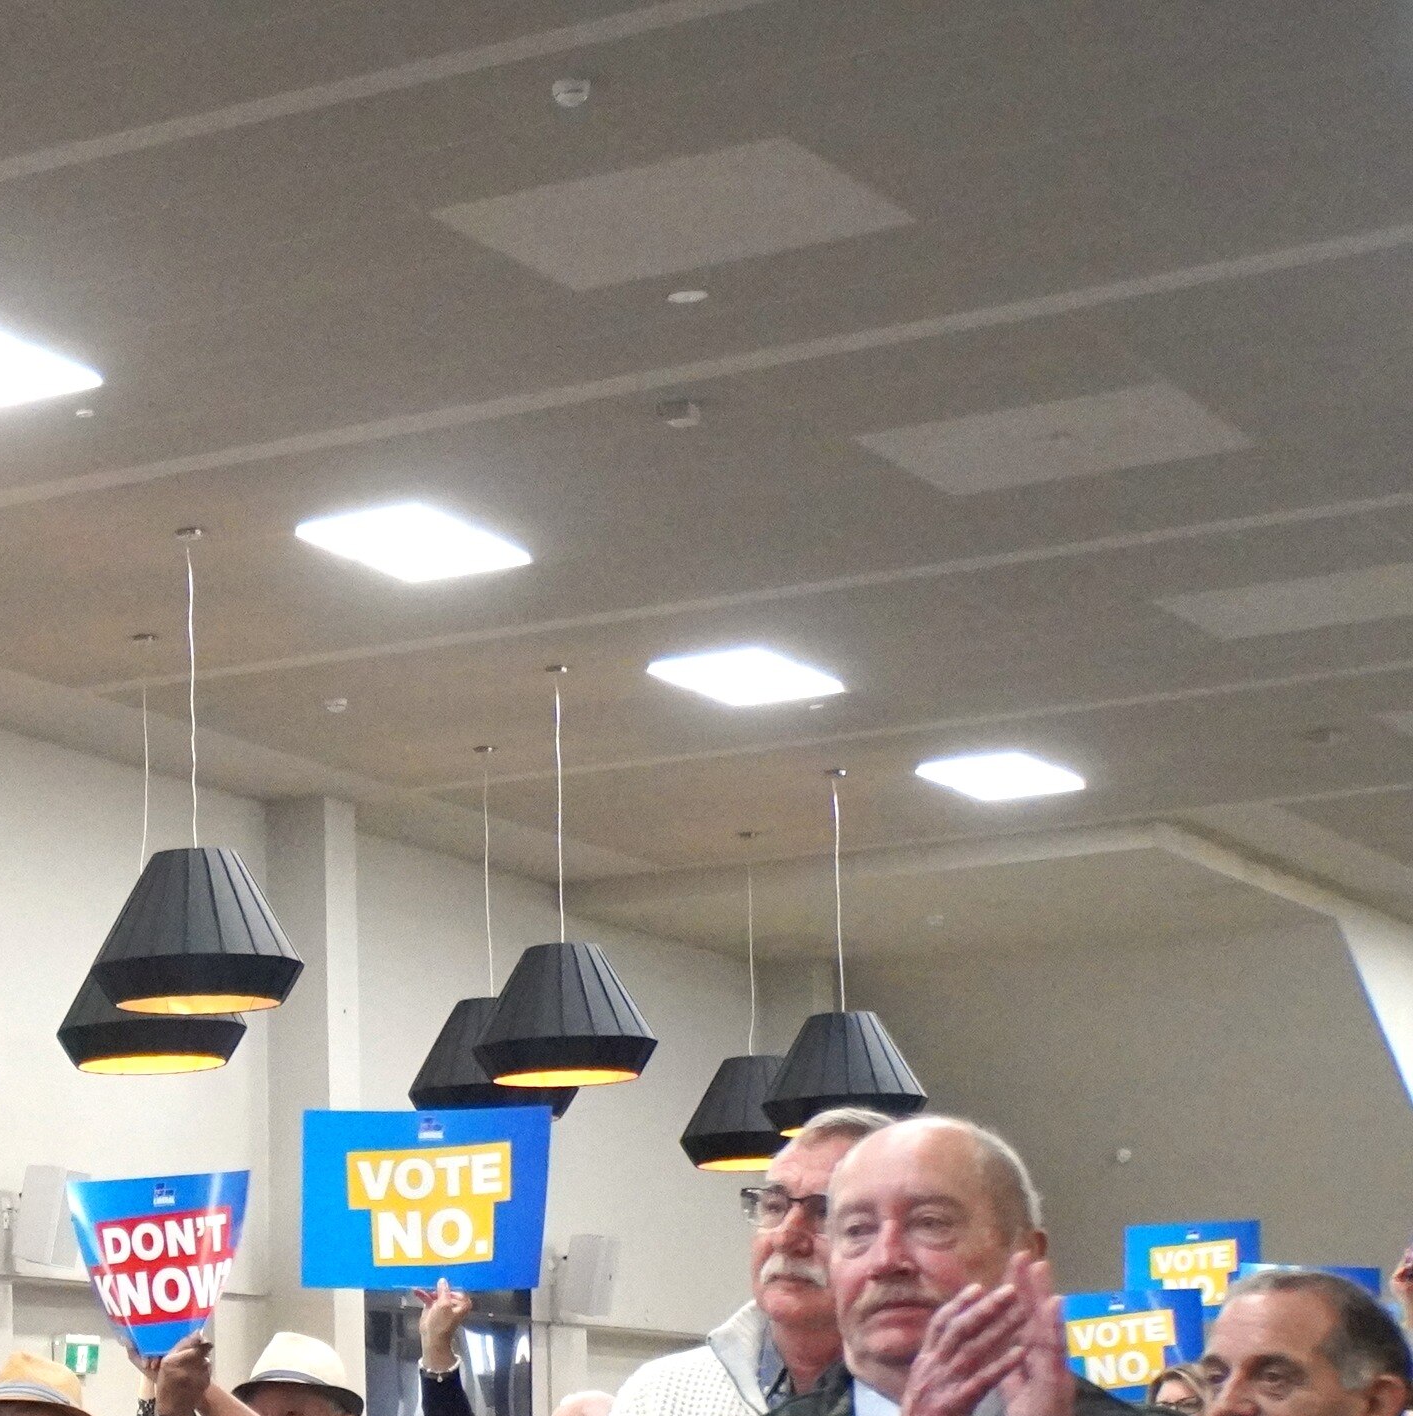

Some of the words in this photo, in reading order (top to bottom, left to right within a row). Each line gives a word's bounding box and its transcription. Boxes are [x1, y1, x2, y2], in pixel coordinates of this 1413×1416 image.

[356, 1152, 503, 1200] VOTE
[101, 1213, 227, 1265] DON'T
[377, 1208, 488, 1259] NO.
[1153, 1245, 1231, 1274] VOTE
[1072, 1315, 1167, 1350] VOTE
